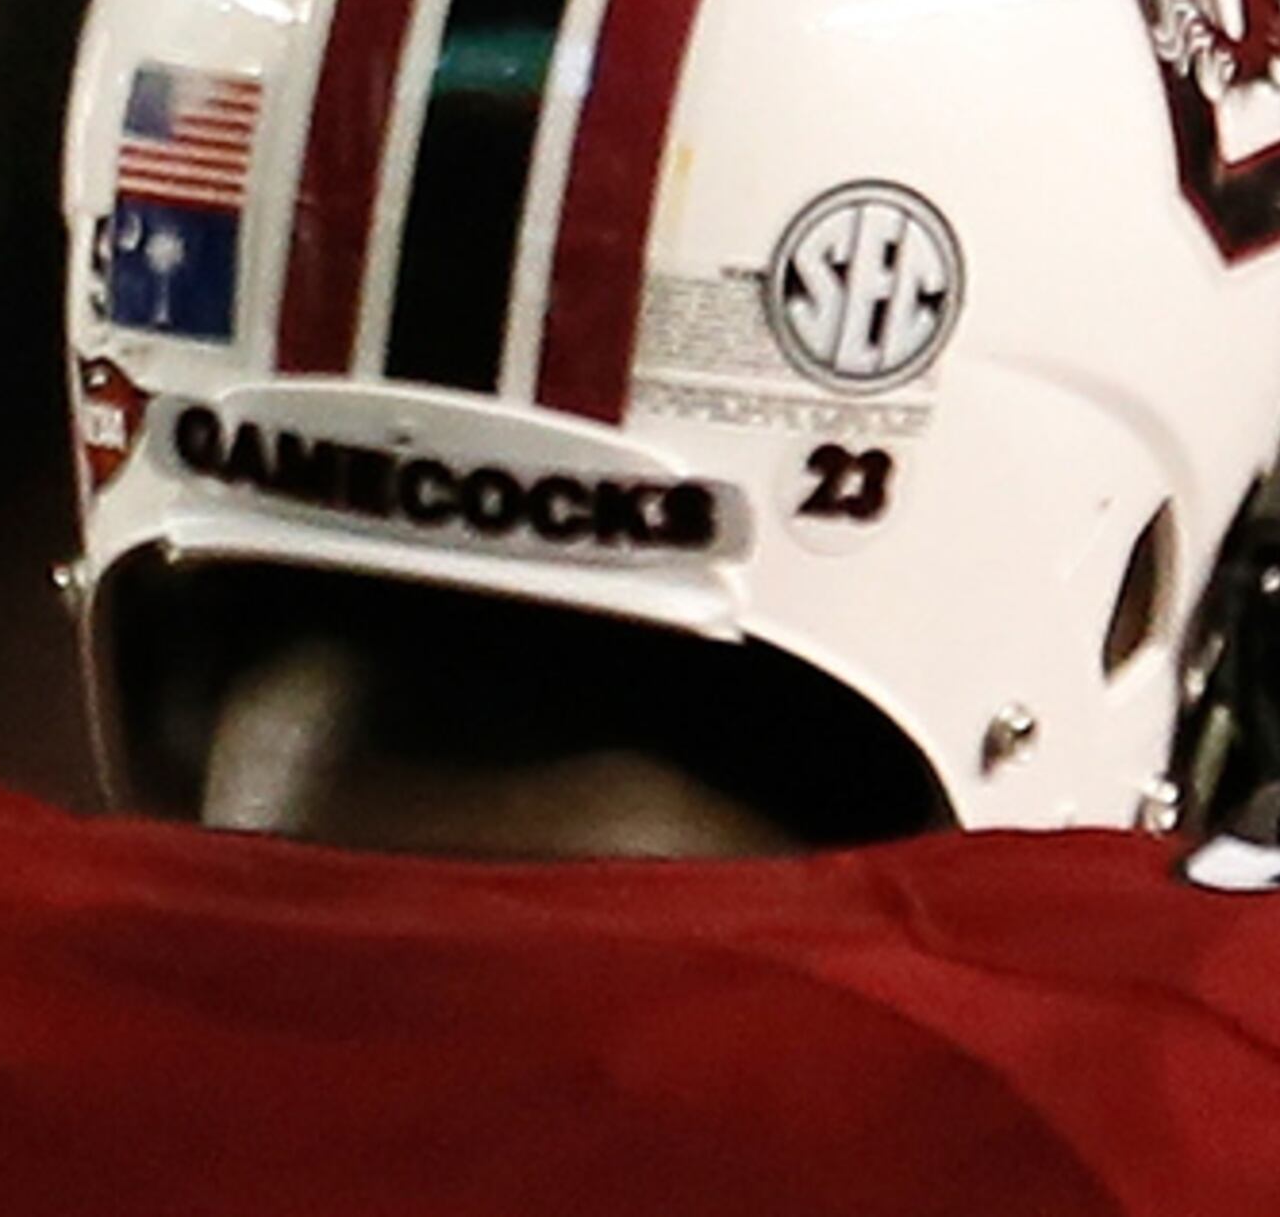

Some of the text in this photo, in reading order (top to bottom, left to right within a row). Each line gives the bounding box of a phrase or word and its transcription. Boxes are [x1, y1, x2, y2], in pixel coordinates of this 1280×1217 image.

[780, 192, 952, 376] SEC
[175, 405, 715, 550] GAMECOCKS
[801, 442, 894, 524] 23
